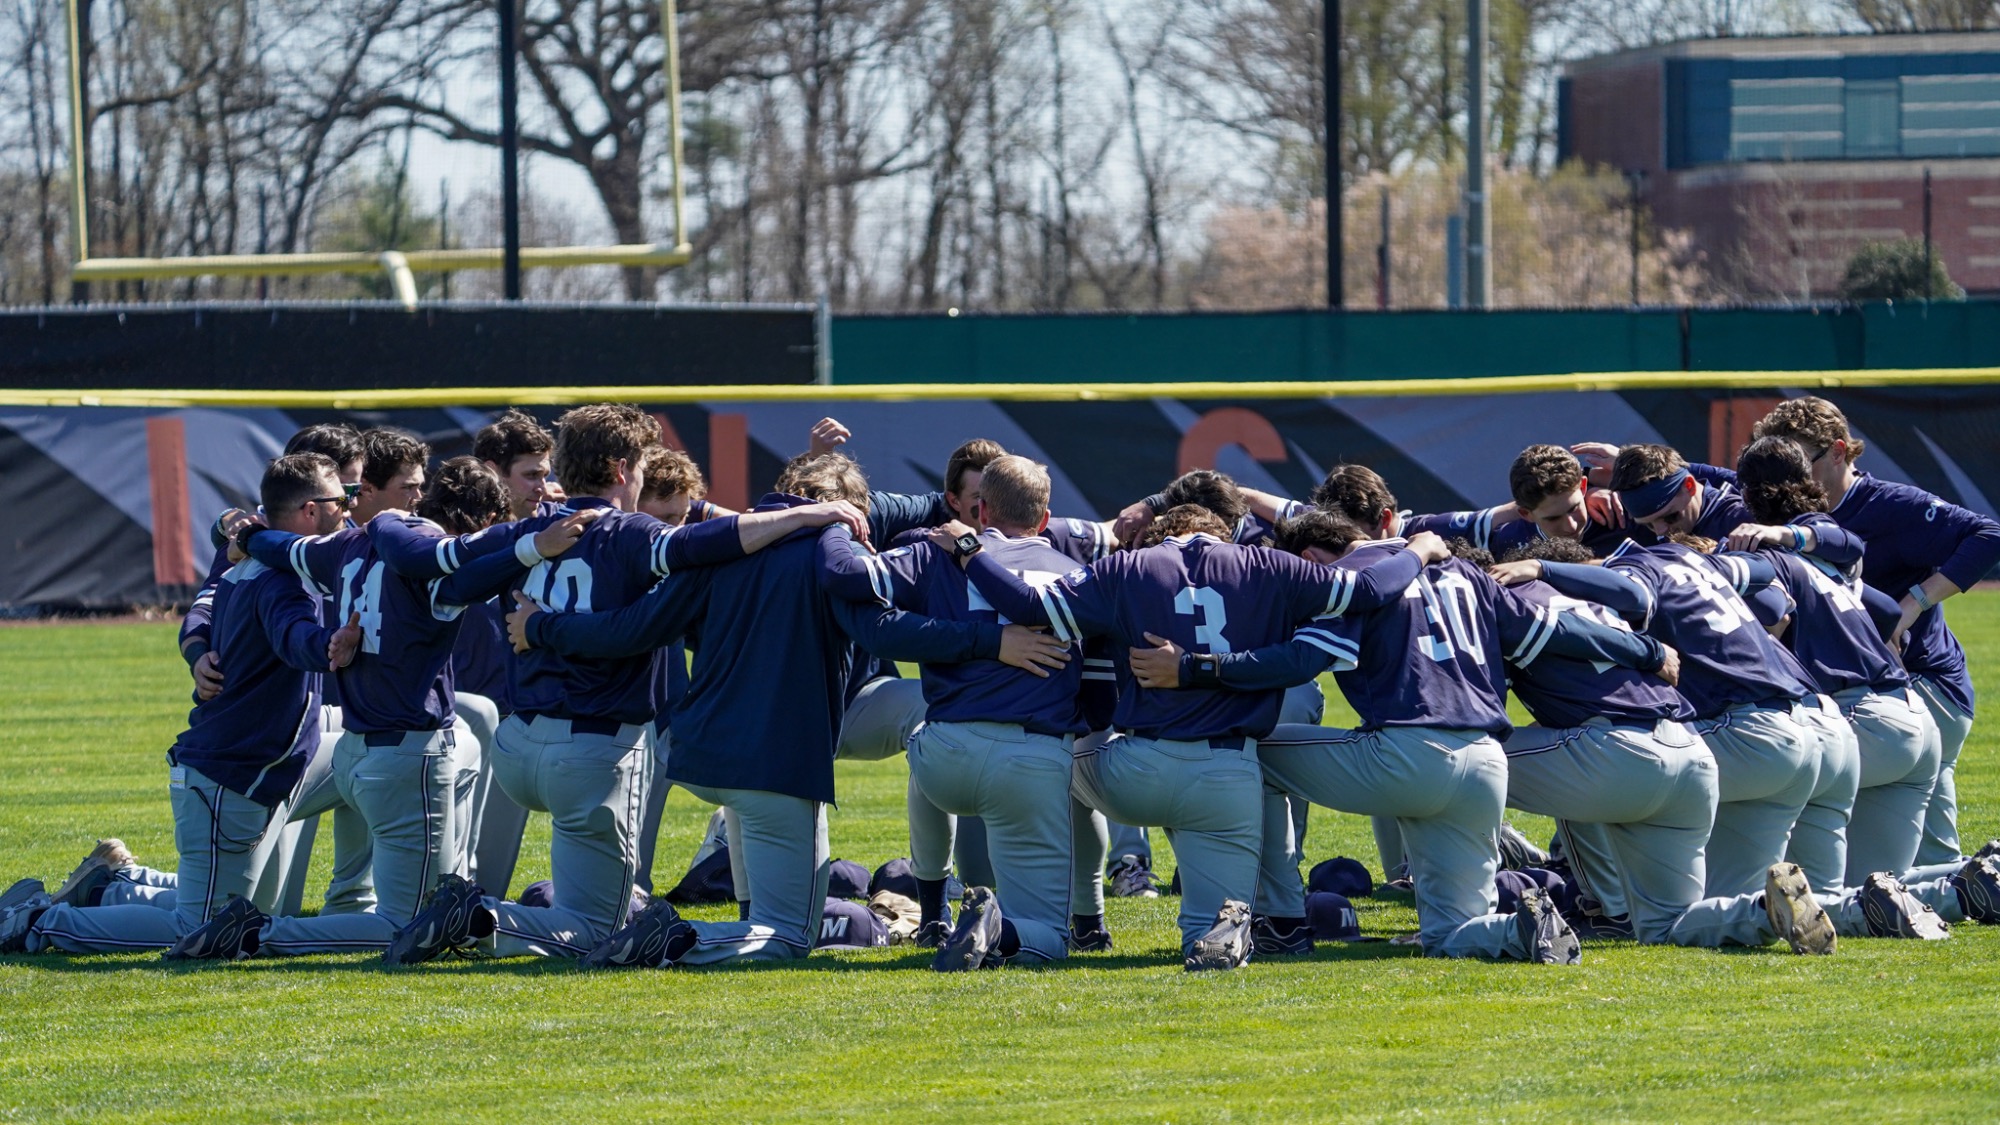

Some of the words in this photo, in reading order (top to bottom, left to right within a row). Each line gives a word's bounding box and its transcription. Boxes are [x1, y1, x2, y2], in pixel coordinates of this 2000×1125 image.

[339, 557, 385, 655] 14
[1174, 586, 1231, 655] 3
[1404, 571, 1486, 665] 30
[820, 915, 850, 940] M
[1340, 907, 1357, 928] M
